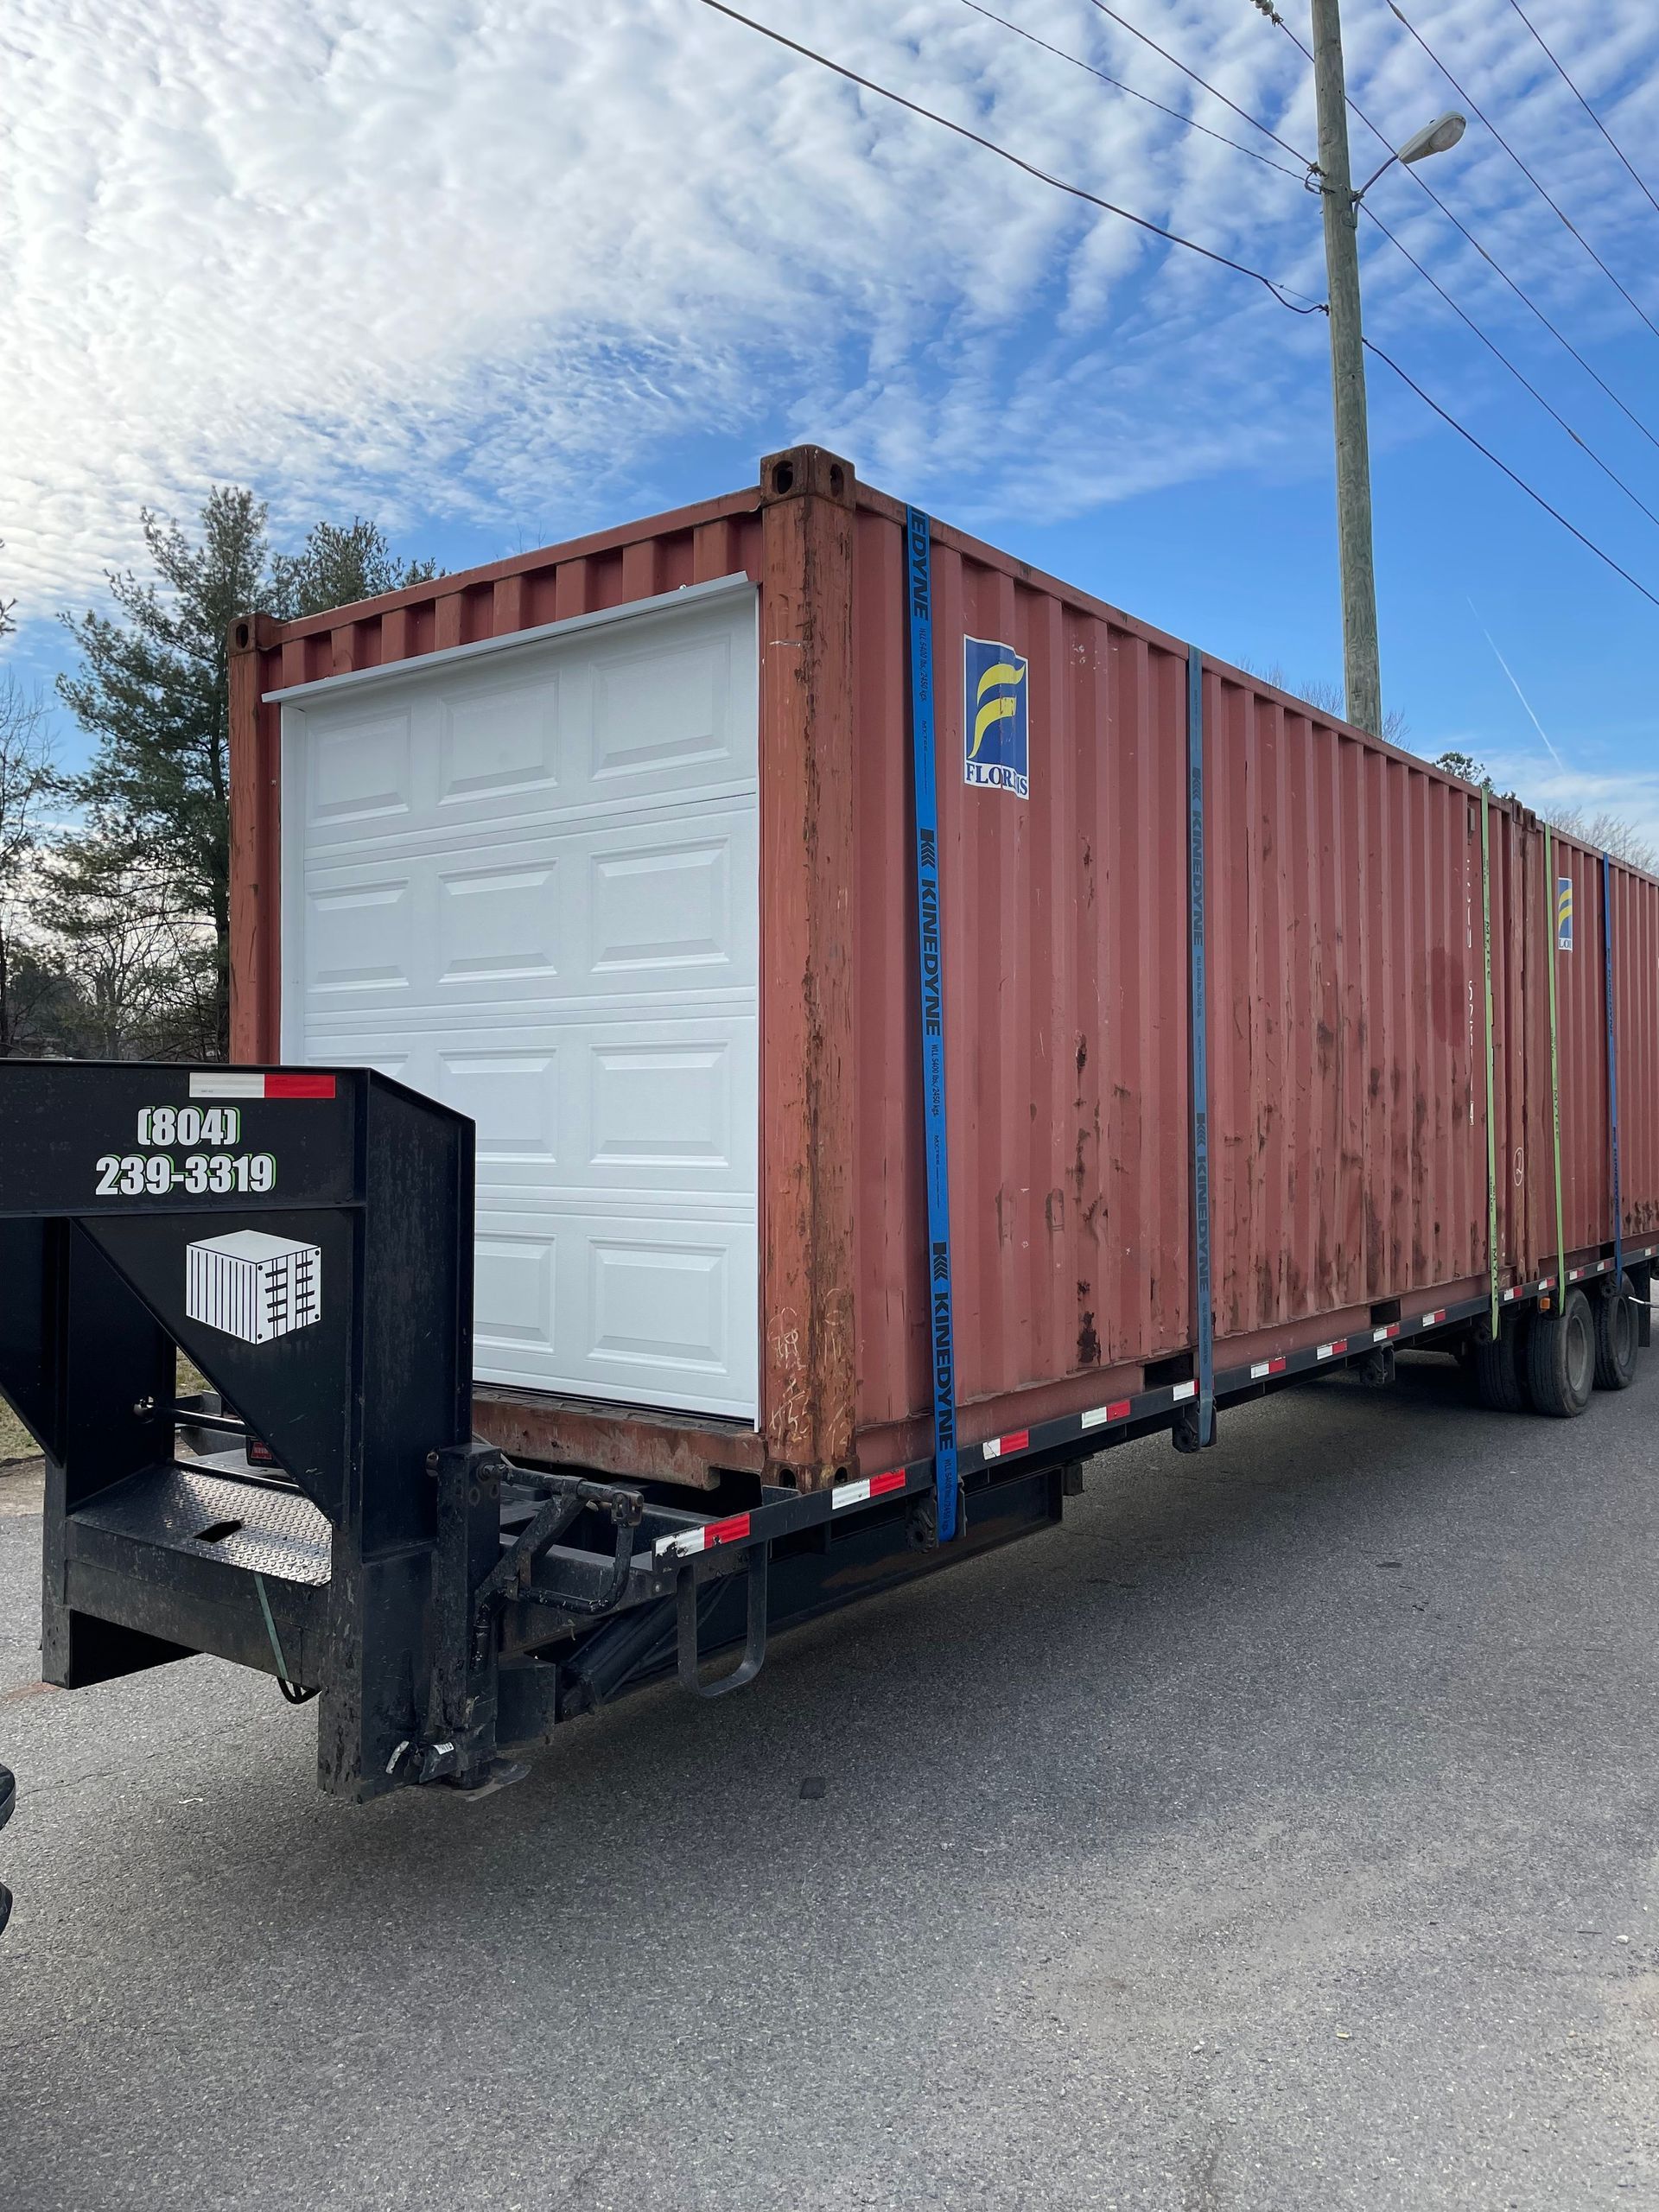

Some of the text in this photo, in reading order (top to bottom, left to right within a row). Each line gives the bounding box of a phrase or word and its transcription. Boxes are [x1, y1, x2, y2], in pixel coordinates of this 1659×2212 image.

[1192, 810, 1204, 947] KINEDYNE
[920, 878, 941, 1037] KINEDYNE
[931, 1044, 939, 1056] WLL
[95, 1153, 276, 1196] 239-3319
[137, 1106, 240, 1146] (804)
[1197, 1156, 1209, 1294] KINEDYNE
[934, 1293, 954, 1452] KINEDYNE
